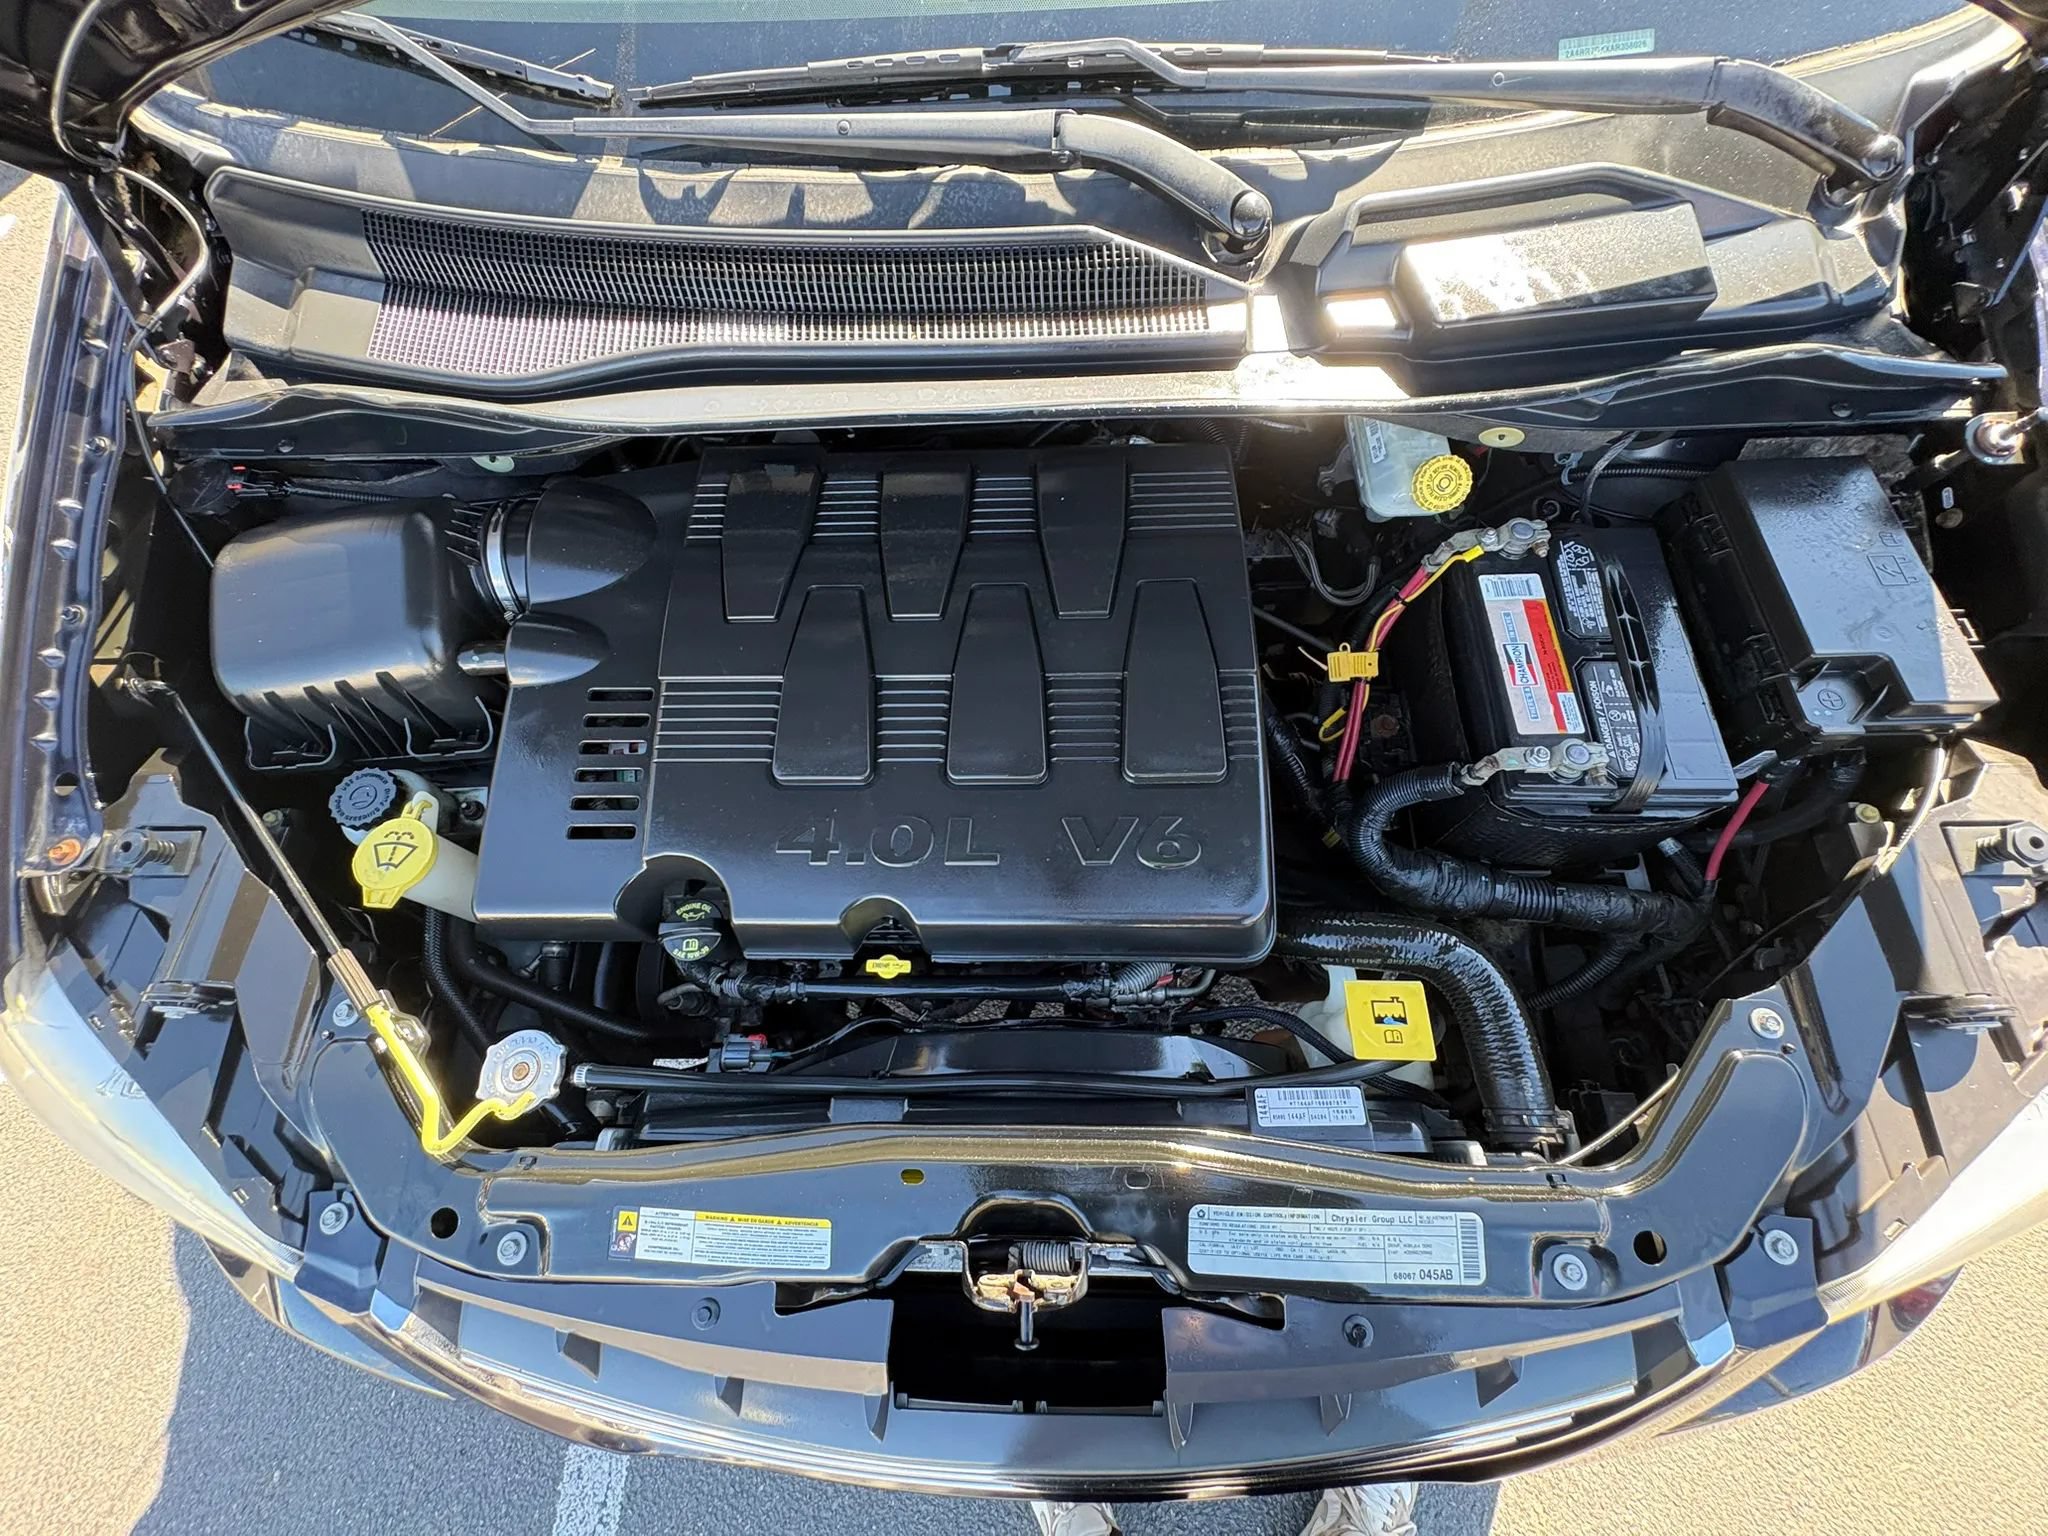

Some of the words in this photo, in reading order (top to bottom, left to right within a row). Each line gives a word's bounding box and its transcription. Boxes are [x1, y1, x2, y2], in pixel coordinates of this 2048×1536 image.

[1512, 645, 1529, 684] CHAMPION
[1589, 680, 1603, 710] POISON
[1599, 717, 1614, 750] DANGER
[775, 815, 1001, 869] 4.0L
[1061, 815, 1202, 870] V6
[675, 902, 702, 916] ENGINE
[701, 903, 713, 913] OIL
[1256, 1094, 1269, 1120] 144AF
[1287, 1112, 1306, 1120] 144AF
[1331, 1214, 1367, 1225] Chrysler
[1371, 1215, 1396, 1226] Group
[1398, 1216, 1413, 1224] LLC
[1393, 1271, 1417, 1280] 68067
[1419, 1268, 1454, 1281] 045AB
